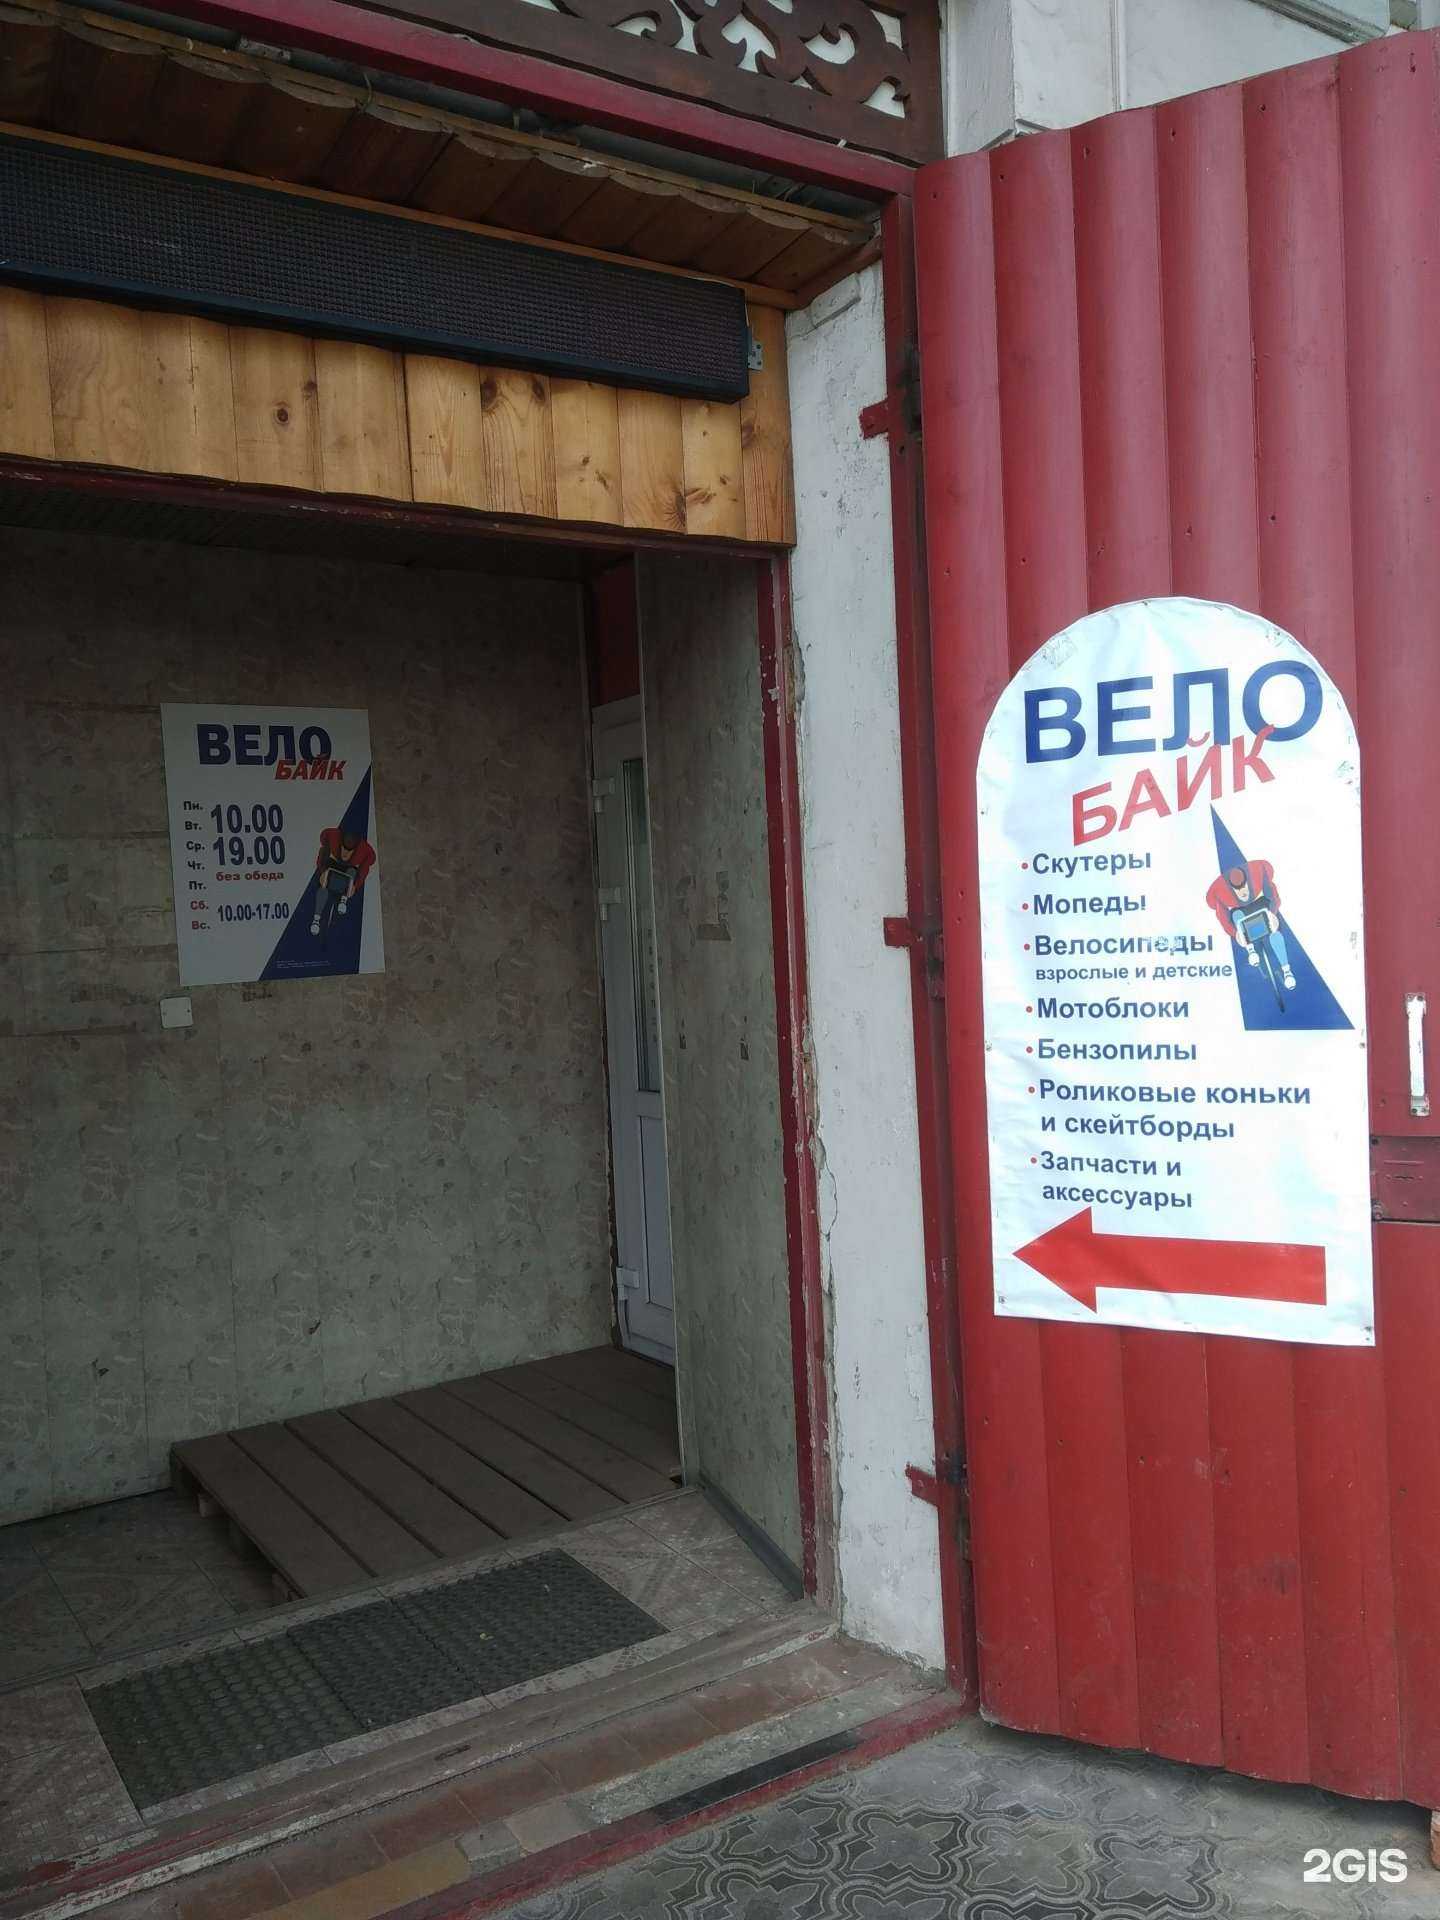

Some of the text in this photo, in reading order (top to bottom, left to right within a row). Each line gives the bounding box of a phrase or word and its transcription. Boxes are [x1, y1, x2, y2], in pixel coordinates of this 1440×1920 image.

[1024, 660, 1323, 764] ВЕЛО
[197, 724, 332, 765] ВЕЛО
[275, 754, 347, 780] БАЙК
[1072, 724, 1276, 847] БАЙК
[185, 821, 202, 831] Вт.
[211, 804, 283, 833] 10.00
[186, 841, 205, 852] Ср.
[213, 836, 285, 865] 19.00
[187, 861, 205, 870] Чт.
[216, 871, 285, 881] без обеда
[1032, 852, 1151, 878] Скутеры
[189, 881, 207, 890] Пт.
[190, 900, 209, 910] Сб.
[217, 902, 290, 921] 10.00-17.00
[1033, 894, 1146, 917] Мопеды
[191, 920, 211, 930] Вс.
[1035, 934, 1213, 956] Велосипеды
[1036, 964, 1233, 983] взрослые и детские
[1037, 996, 1189, 1019] Мотоблоки
[1038, 1038, 1197, 1061] Бензопилы
[1039, 1078, 1311, 1105] Роликовые коньки
[1041, 1112, 1235, 1142] и скейтборды
[1040, 1151, 1182, 1177] Запчасти и
[1042, 1183, 1193, 1211] аксессуары
